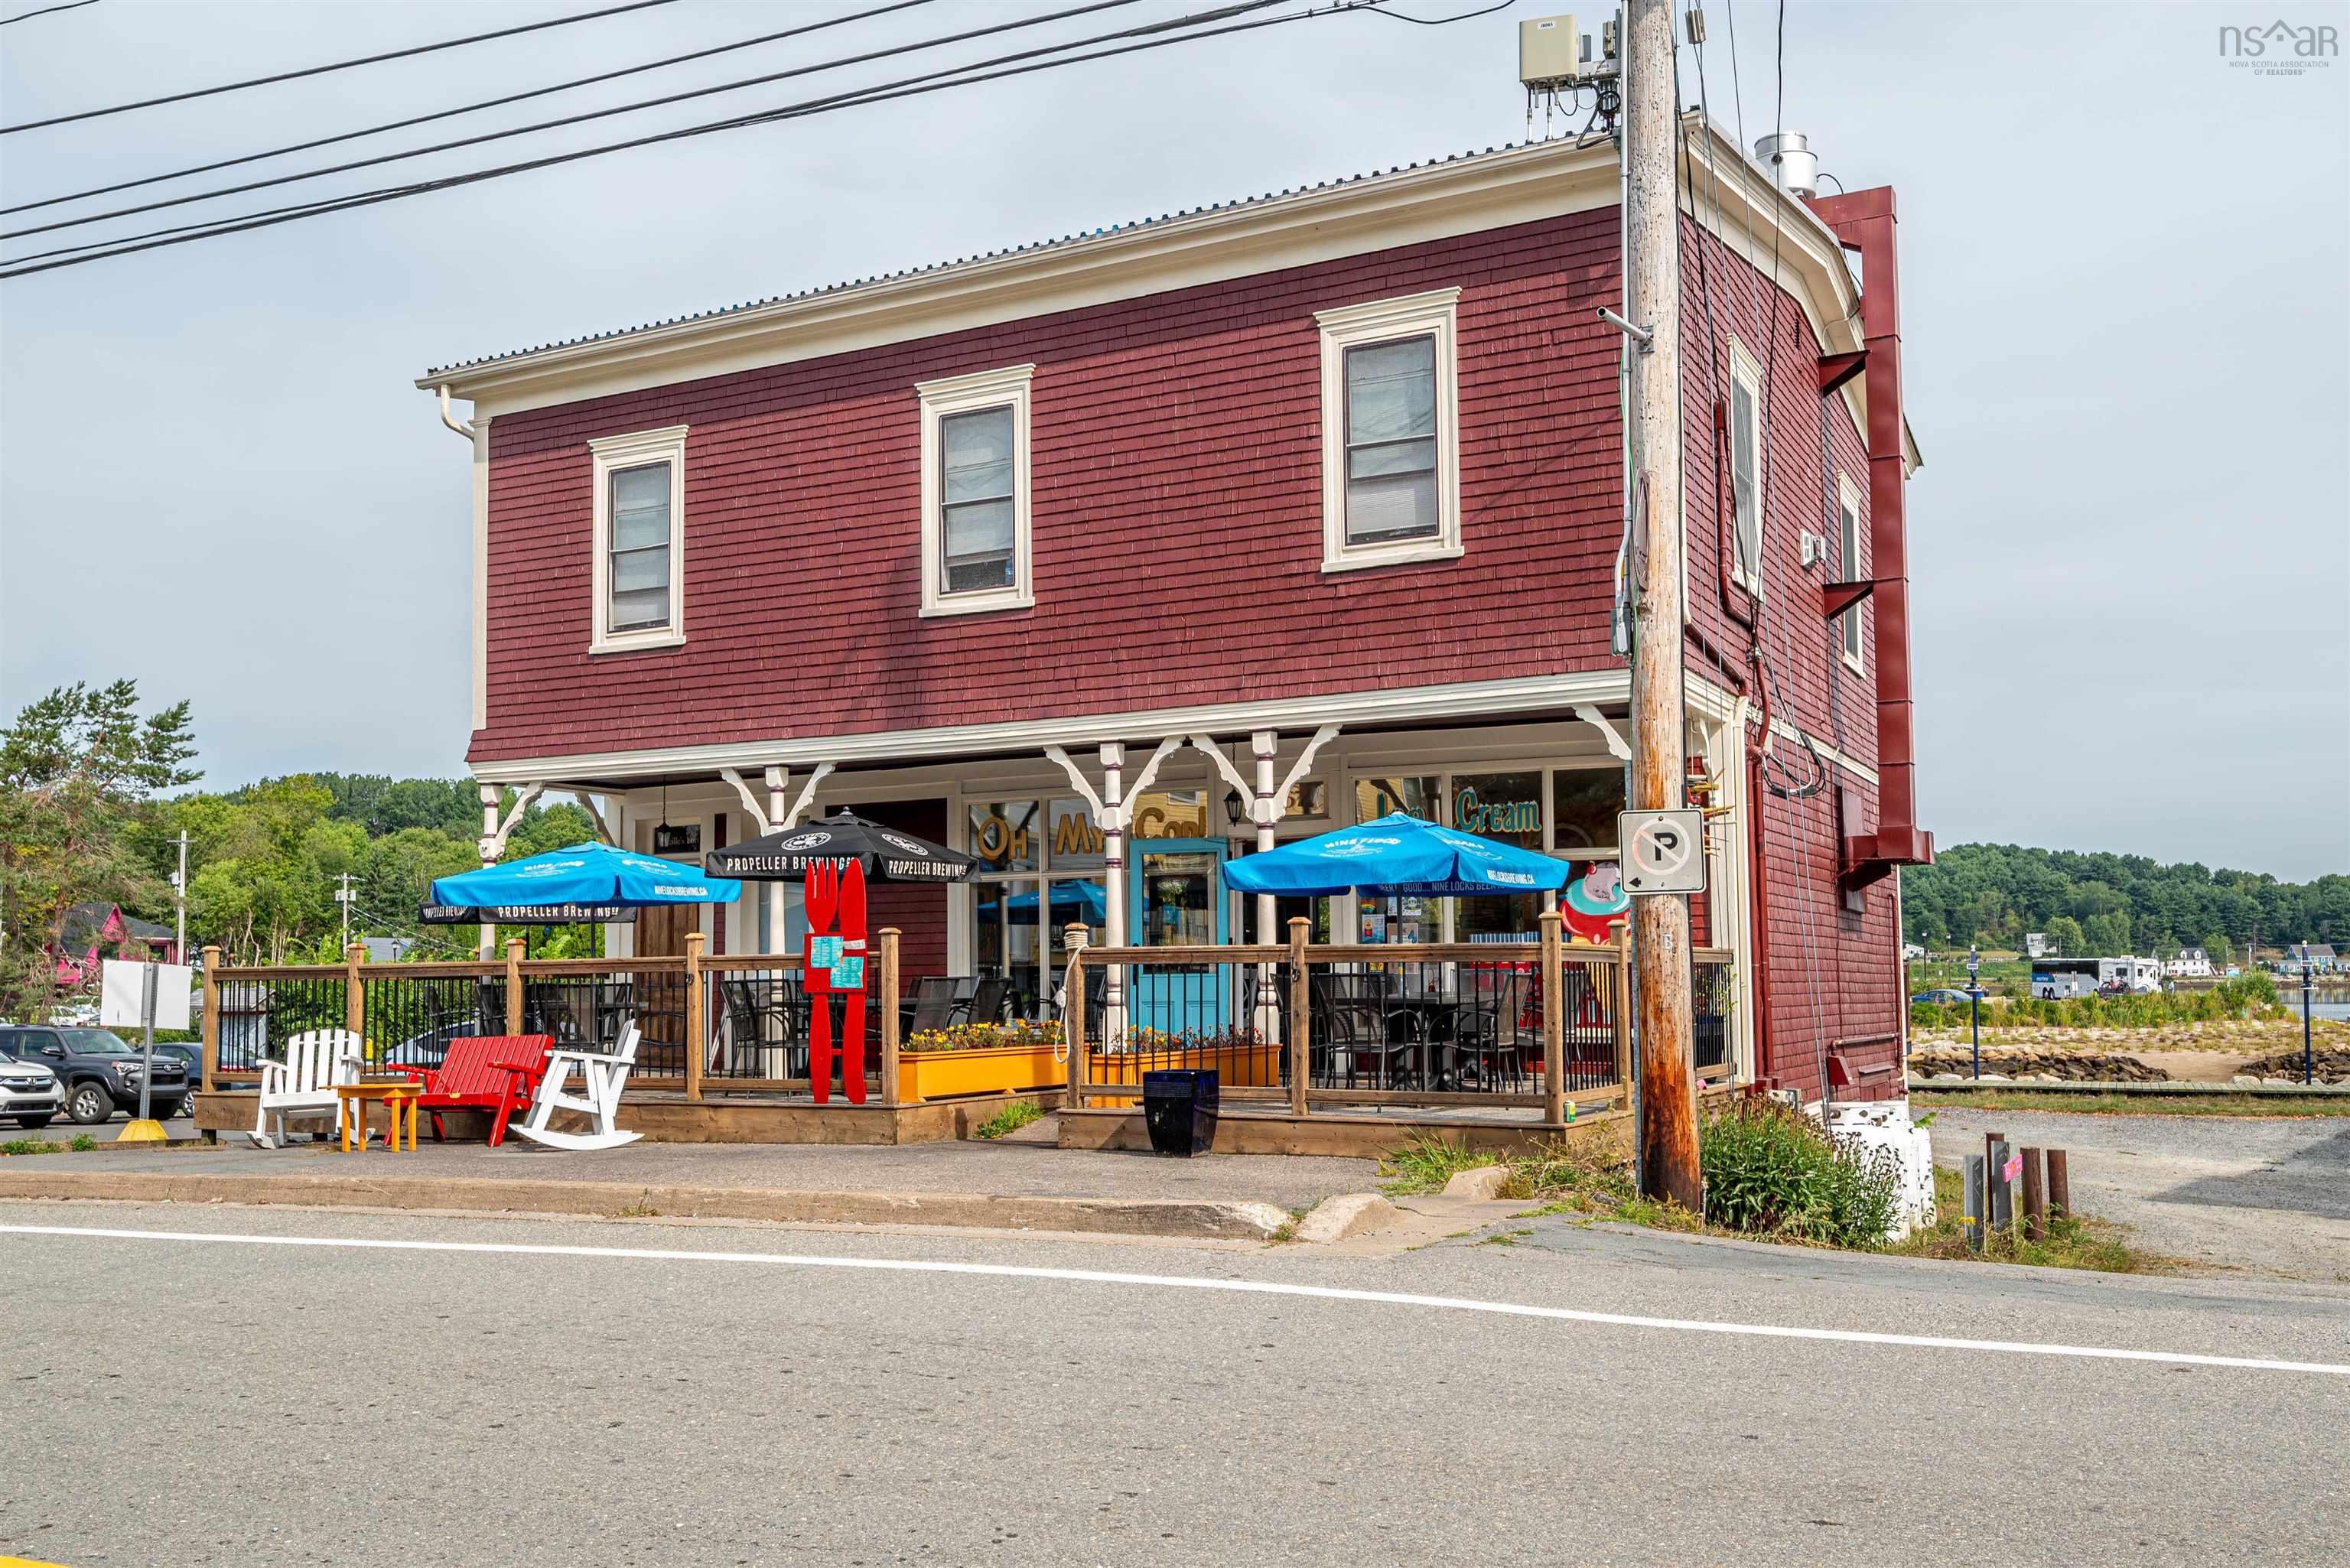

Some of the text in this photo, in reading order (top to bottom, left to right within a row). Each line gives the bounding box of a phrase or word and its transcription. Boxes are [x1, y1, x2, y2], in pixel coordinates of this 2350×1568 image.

[1456, 786, 1542, 833] Cream
[1654, 832, 1678, 861] P
[727, 856, 787, 871] PROPELLER
[888, 860, 930, 876] PROPELLER
[1432, 882, 1449, 892] NINE
[1451, 881, 1474, 892] LOCKS
[497, 906, 558, 918] PROPELLER
